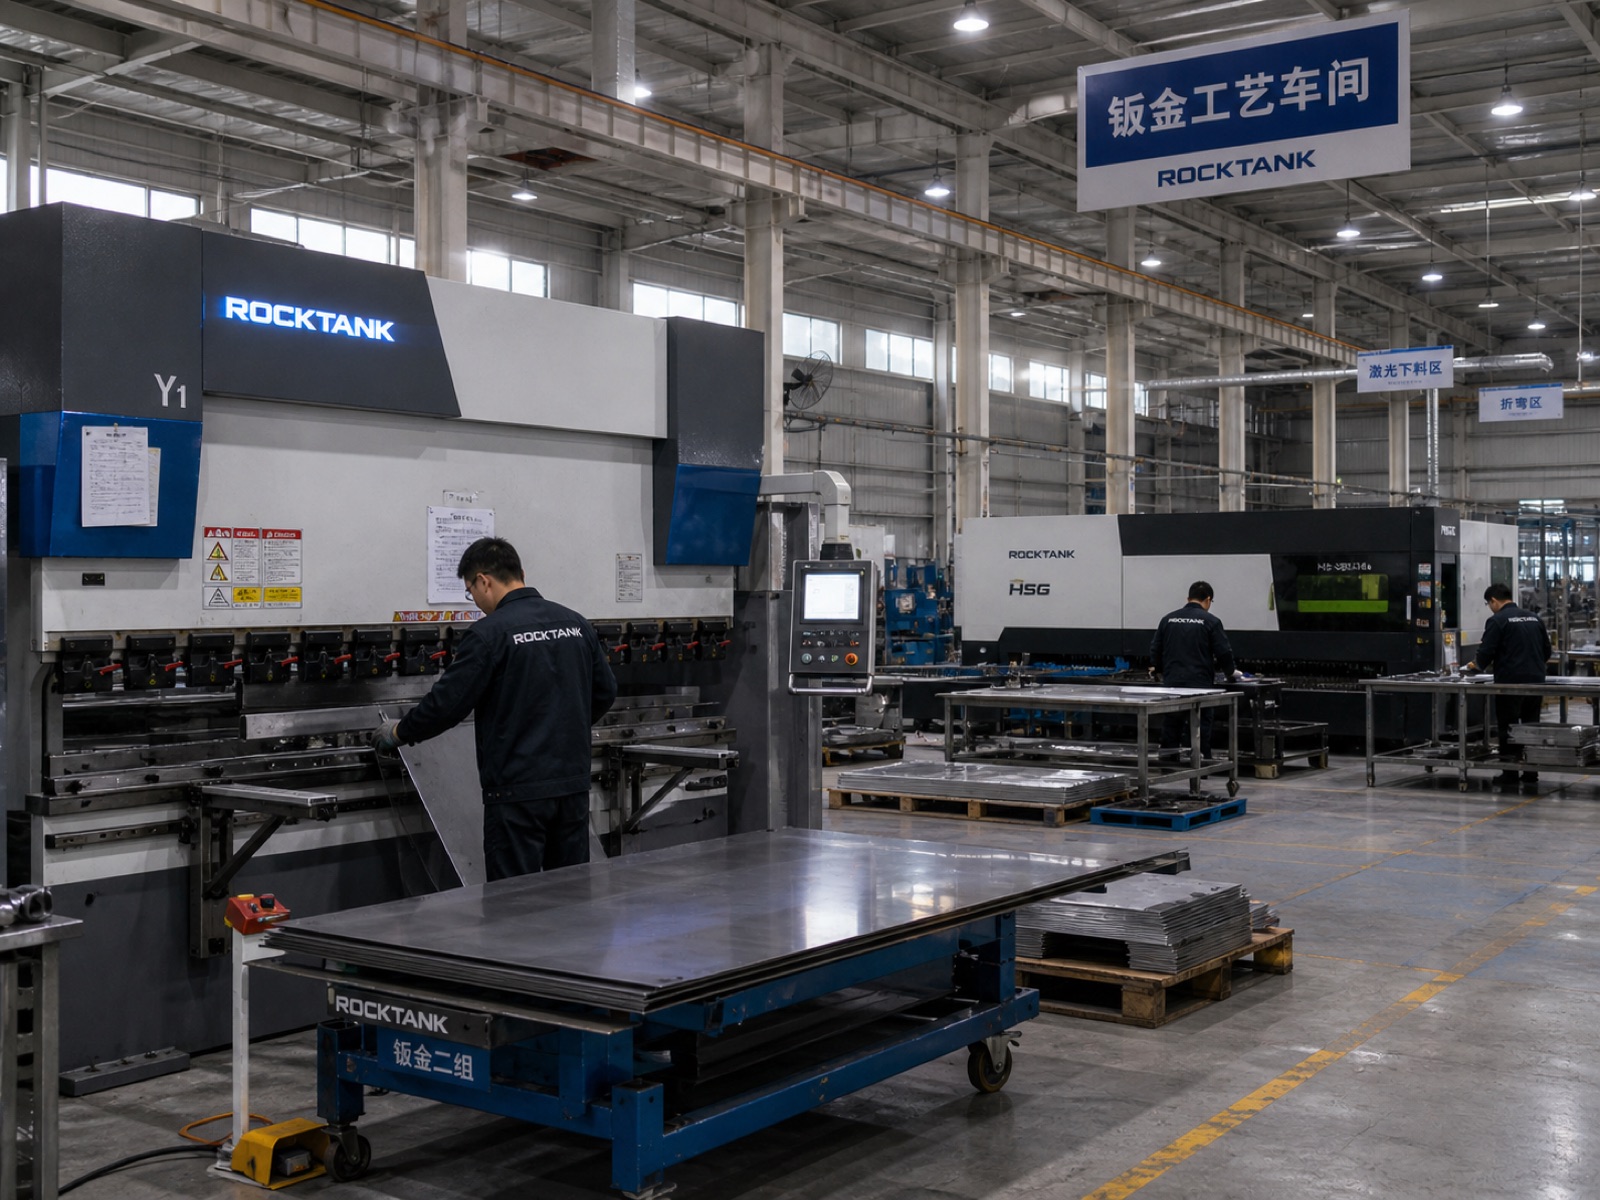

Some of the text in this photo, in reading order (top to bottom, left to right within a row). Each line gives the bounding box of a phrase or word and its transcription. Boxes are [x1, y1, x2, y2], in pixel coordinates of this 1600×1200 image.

[1108, 57, 1369, 138] 钣金工艺车间
[1157, 149, 1316, 188] ROCKTANK
[225, 296, 395, 342] ROCKTANK
[1369, 361, 1442, 379] 激光下料区
[1008, 549, 1075, 559] ROCKTANK
[1009, 583, 1050, 596] HSG
[513, 627, 582, 645] ROCKTANK
[336, 995, 448, 1034] ROCKTANK
[393, 1038, 474, 1081] 钣金二组
